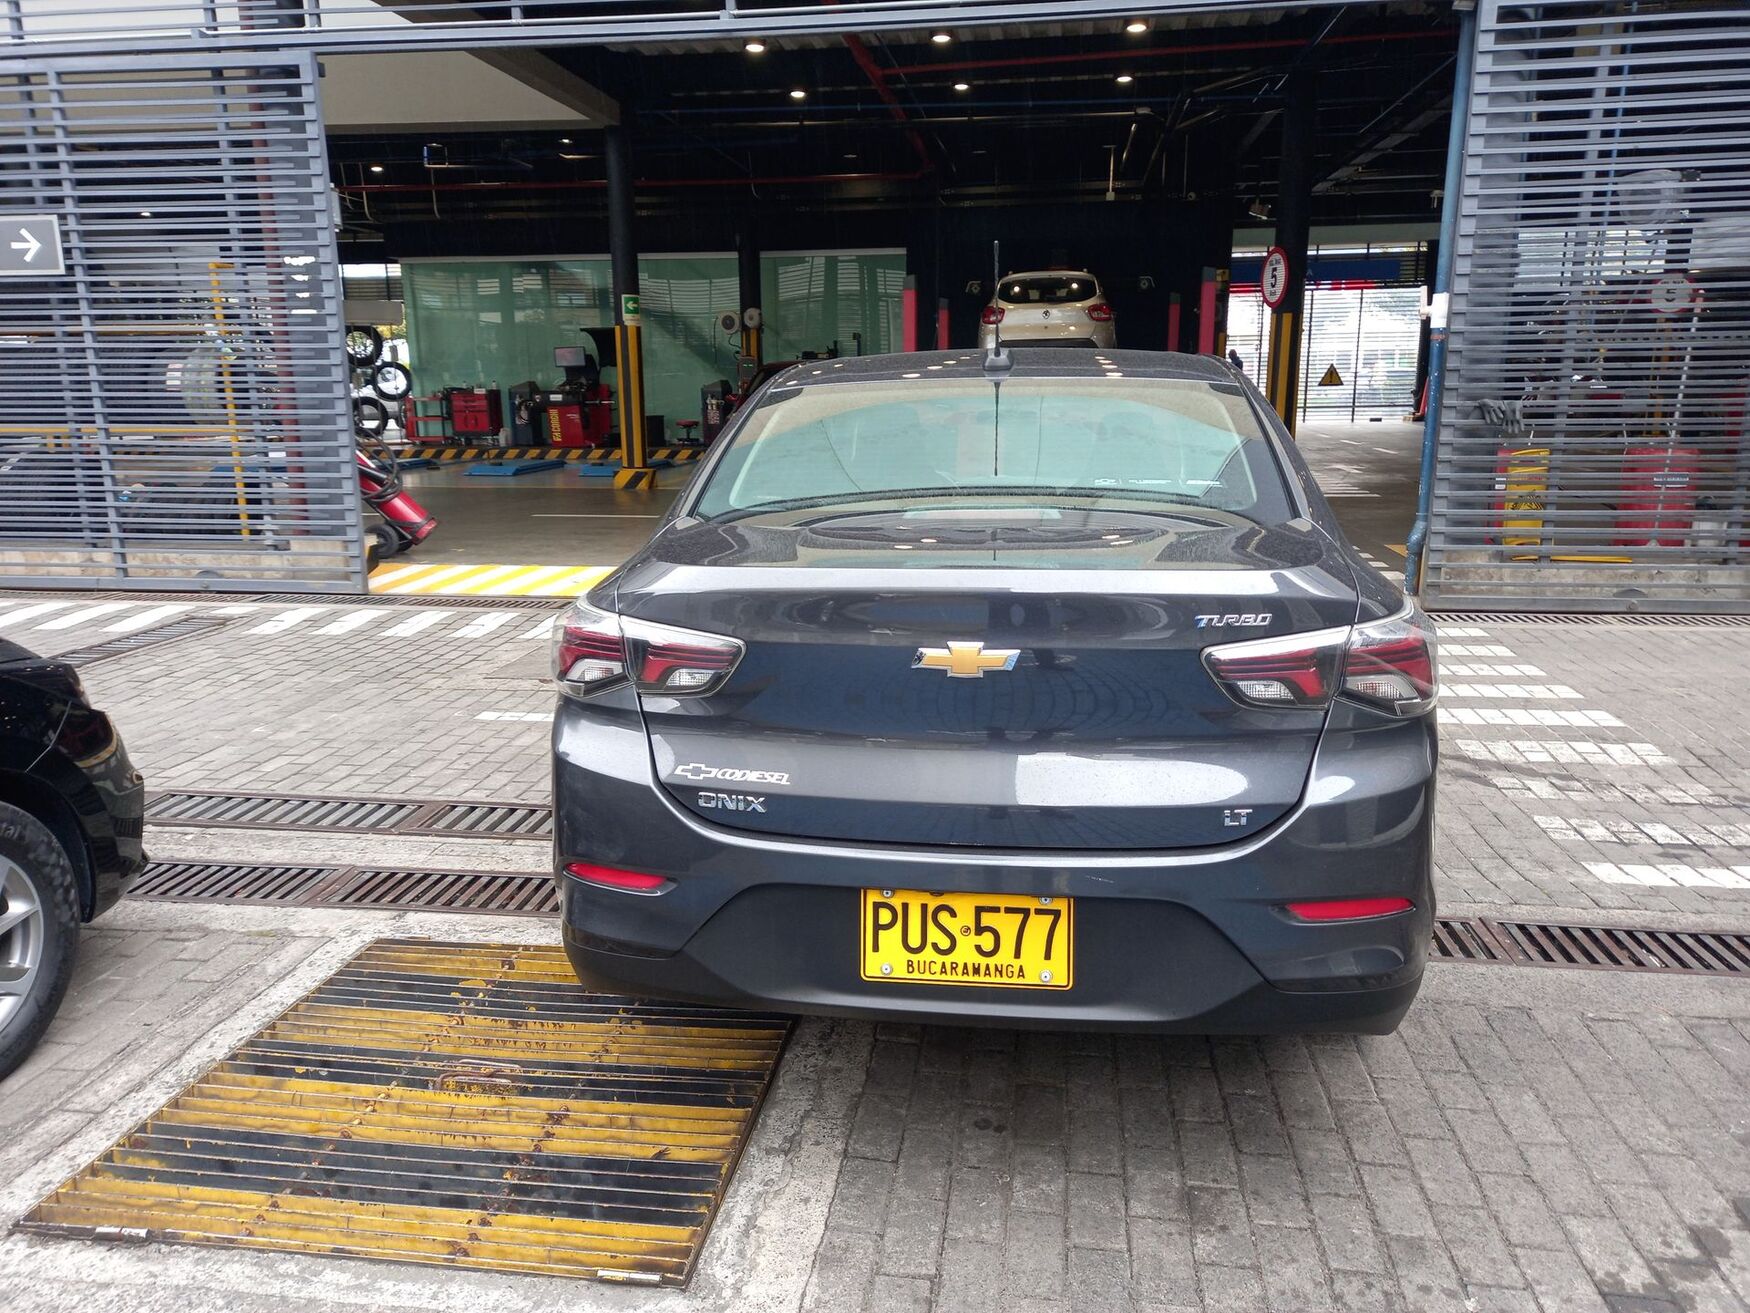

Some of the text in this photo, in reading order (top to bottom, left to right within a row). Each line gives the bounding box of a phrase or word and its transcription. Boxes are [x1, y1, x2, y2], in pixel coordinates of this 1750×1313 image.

[1270, 267, 1278, 288] 5
[1194, 613, 1273, 629] TURBO
[716, 768, 791, 785] CODIESEL
[698, 791, 767, 813] ONIX
[1223, 809, 1253, 827] LT
[871, 901, 1062, 961] PUS 577
[906, 959, 1026, 979] BUCARAMANGA
